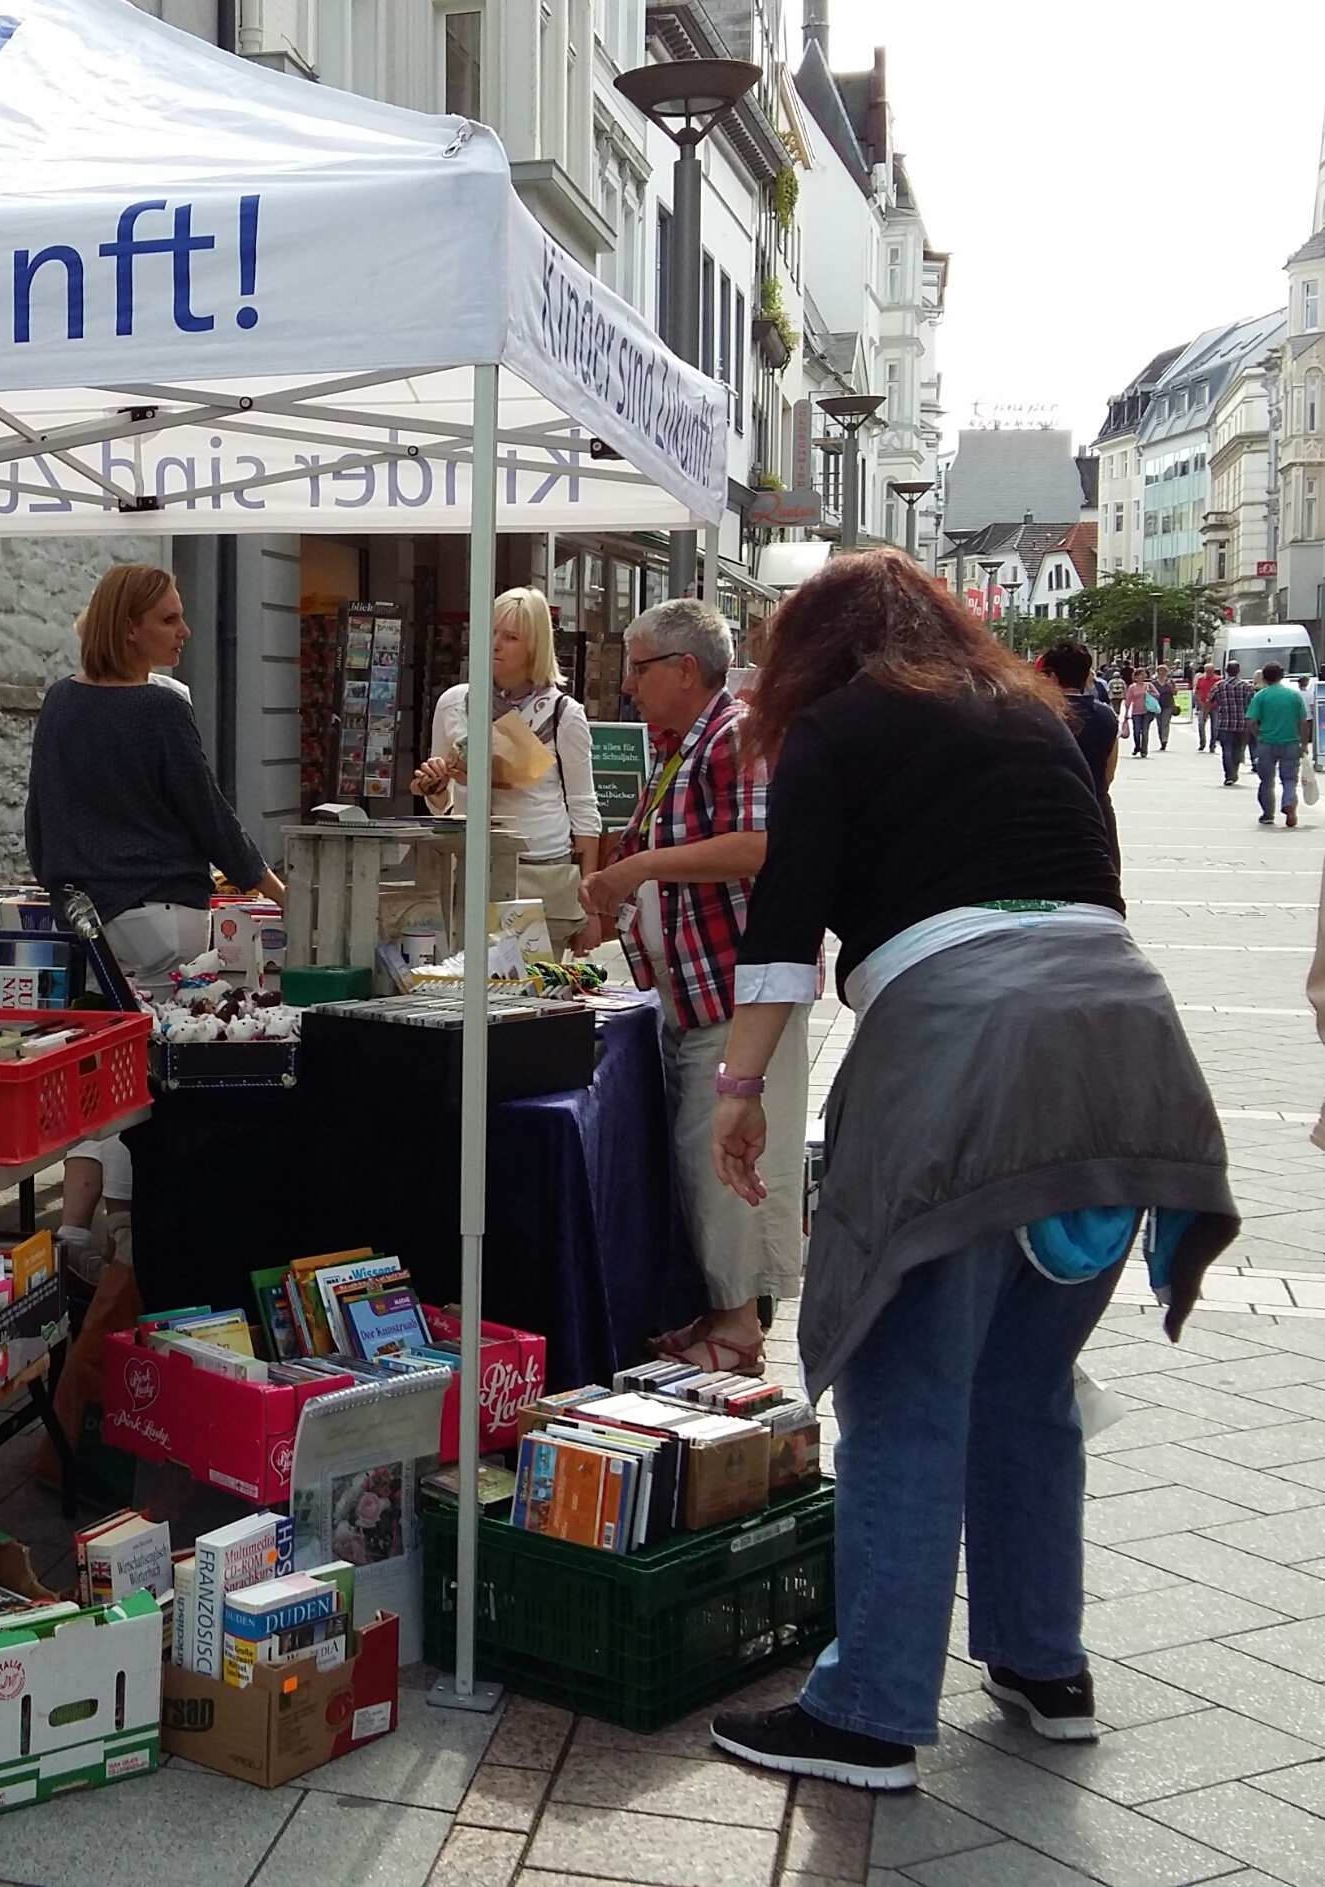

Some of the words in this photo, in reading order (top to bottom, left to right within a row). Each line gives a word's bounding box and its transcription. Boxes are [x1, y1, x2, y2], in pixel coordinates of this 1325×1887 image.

[542, 237, 616, 402] Kinder
[616, 337, 657, 438] sind
[129, 1368, 152, 1388] Pink
[107, 1409, 142, 1432] Pink
[141, 1416, 171, 1450] Lady
[225, 1534, 275, 1564] Multimedia
[224, 1553, 264, 1581] CD-ROM
[225, 1609, 256, 1628] DUDEN
[266, 1597, 330, 1633] DUDEN
